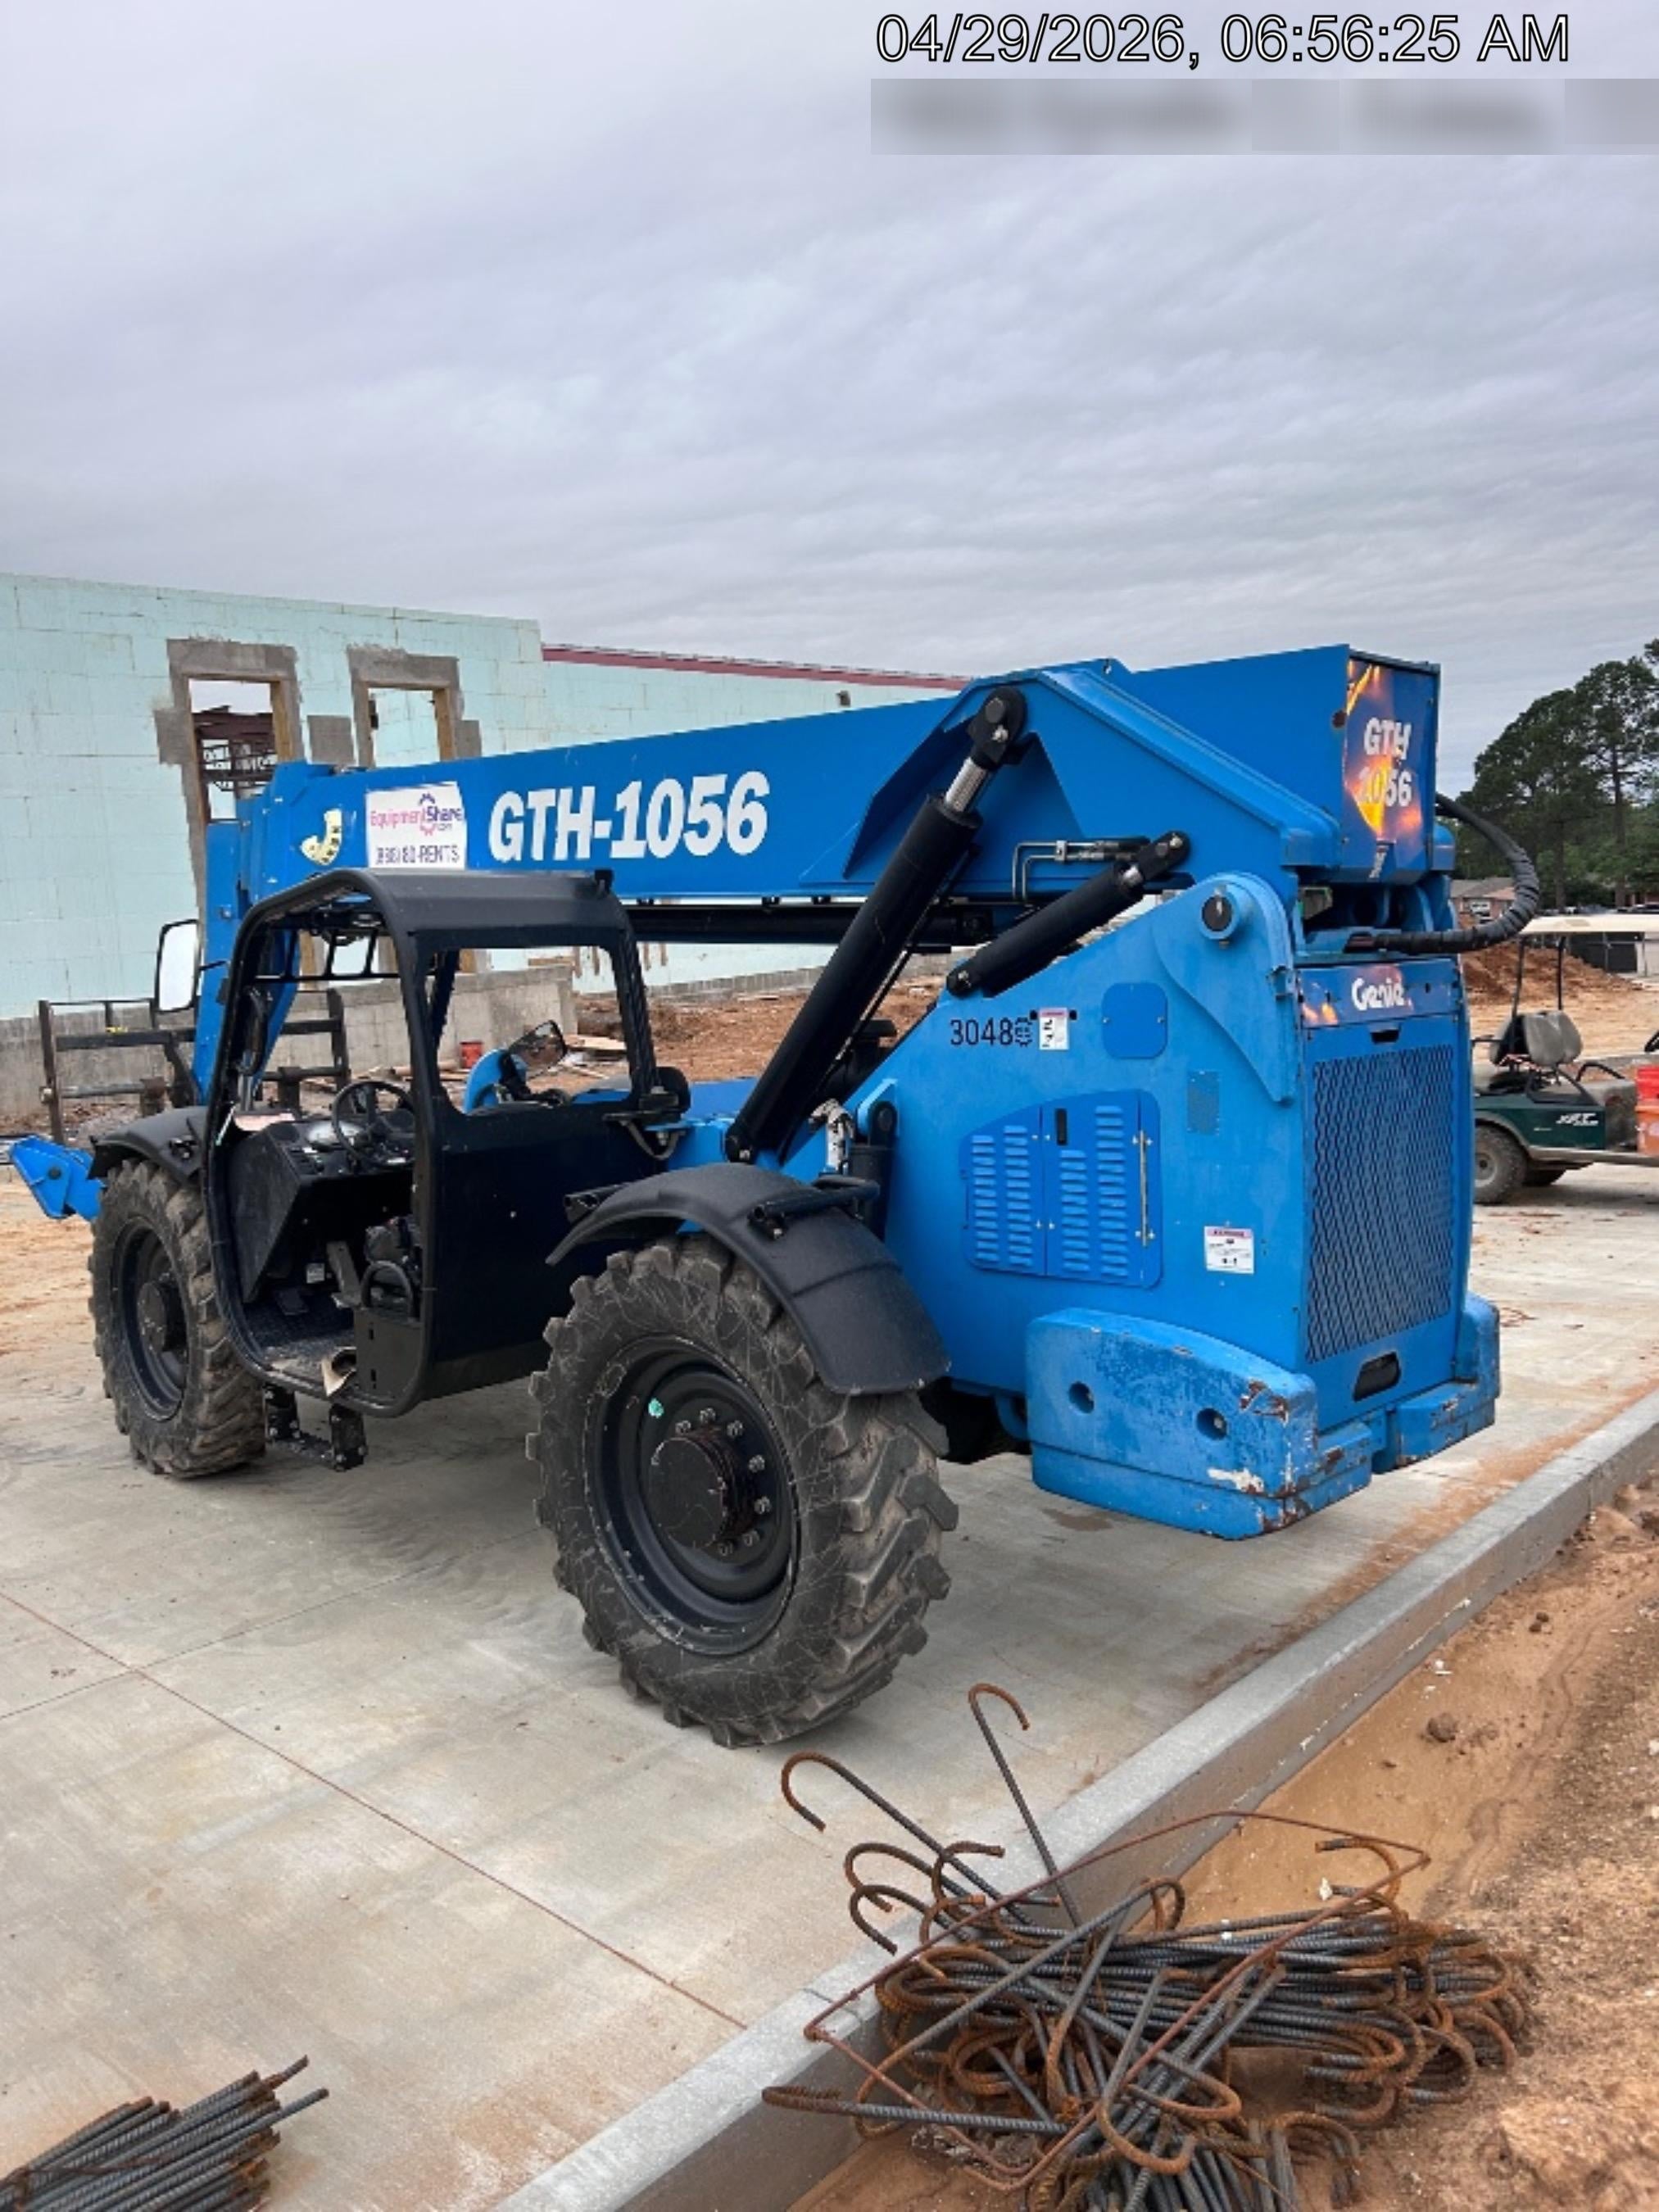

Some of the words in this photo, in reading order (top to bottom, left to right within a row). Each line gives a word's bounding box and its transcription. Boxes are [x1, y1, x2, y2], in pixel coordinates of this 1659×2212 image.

[1363, 717, 1412, 760] GTH
[1358, 766, 1412, 808] 1056
[488, 771, 770, 863] GTH-1056
[1352, 977, 1406, 1011] Genie
